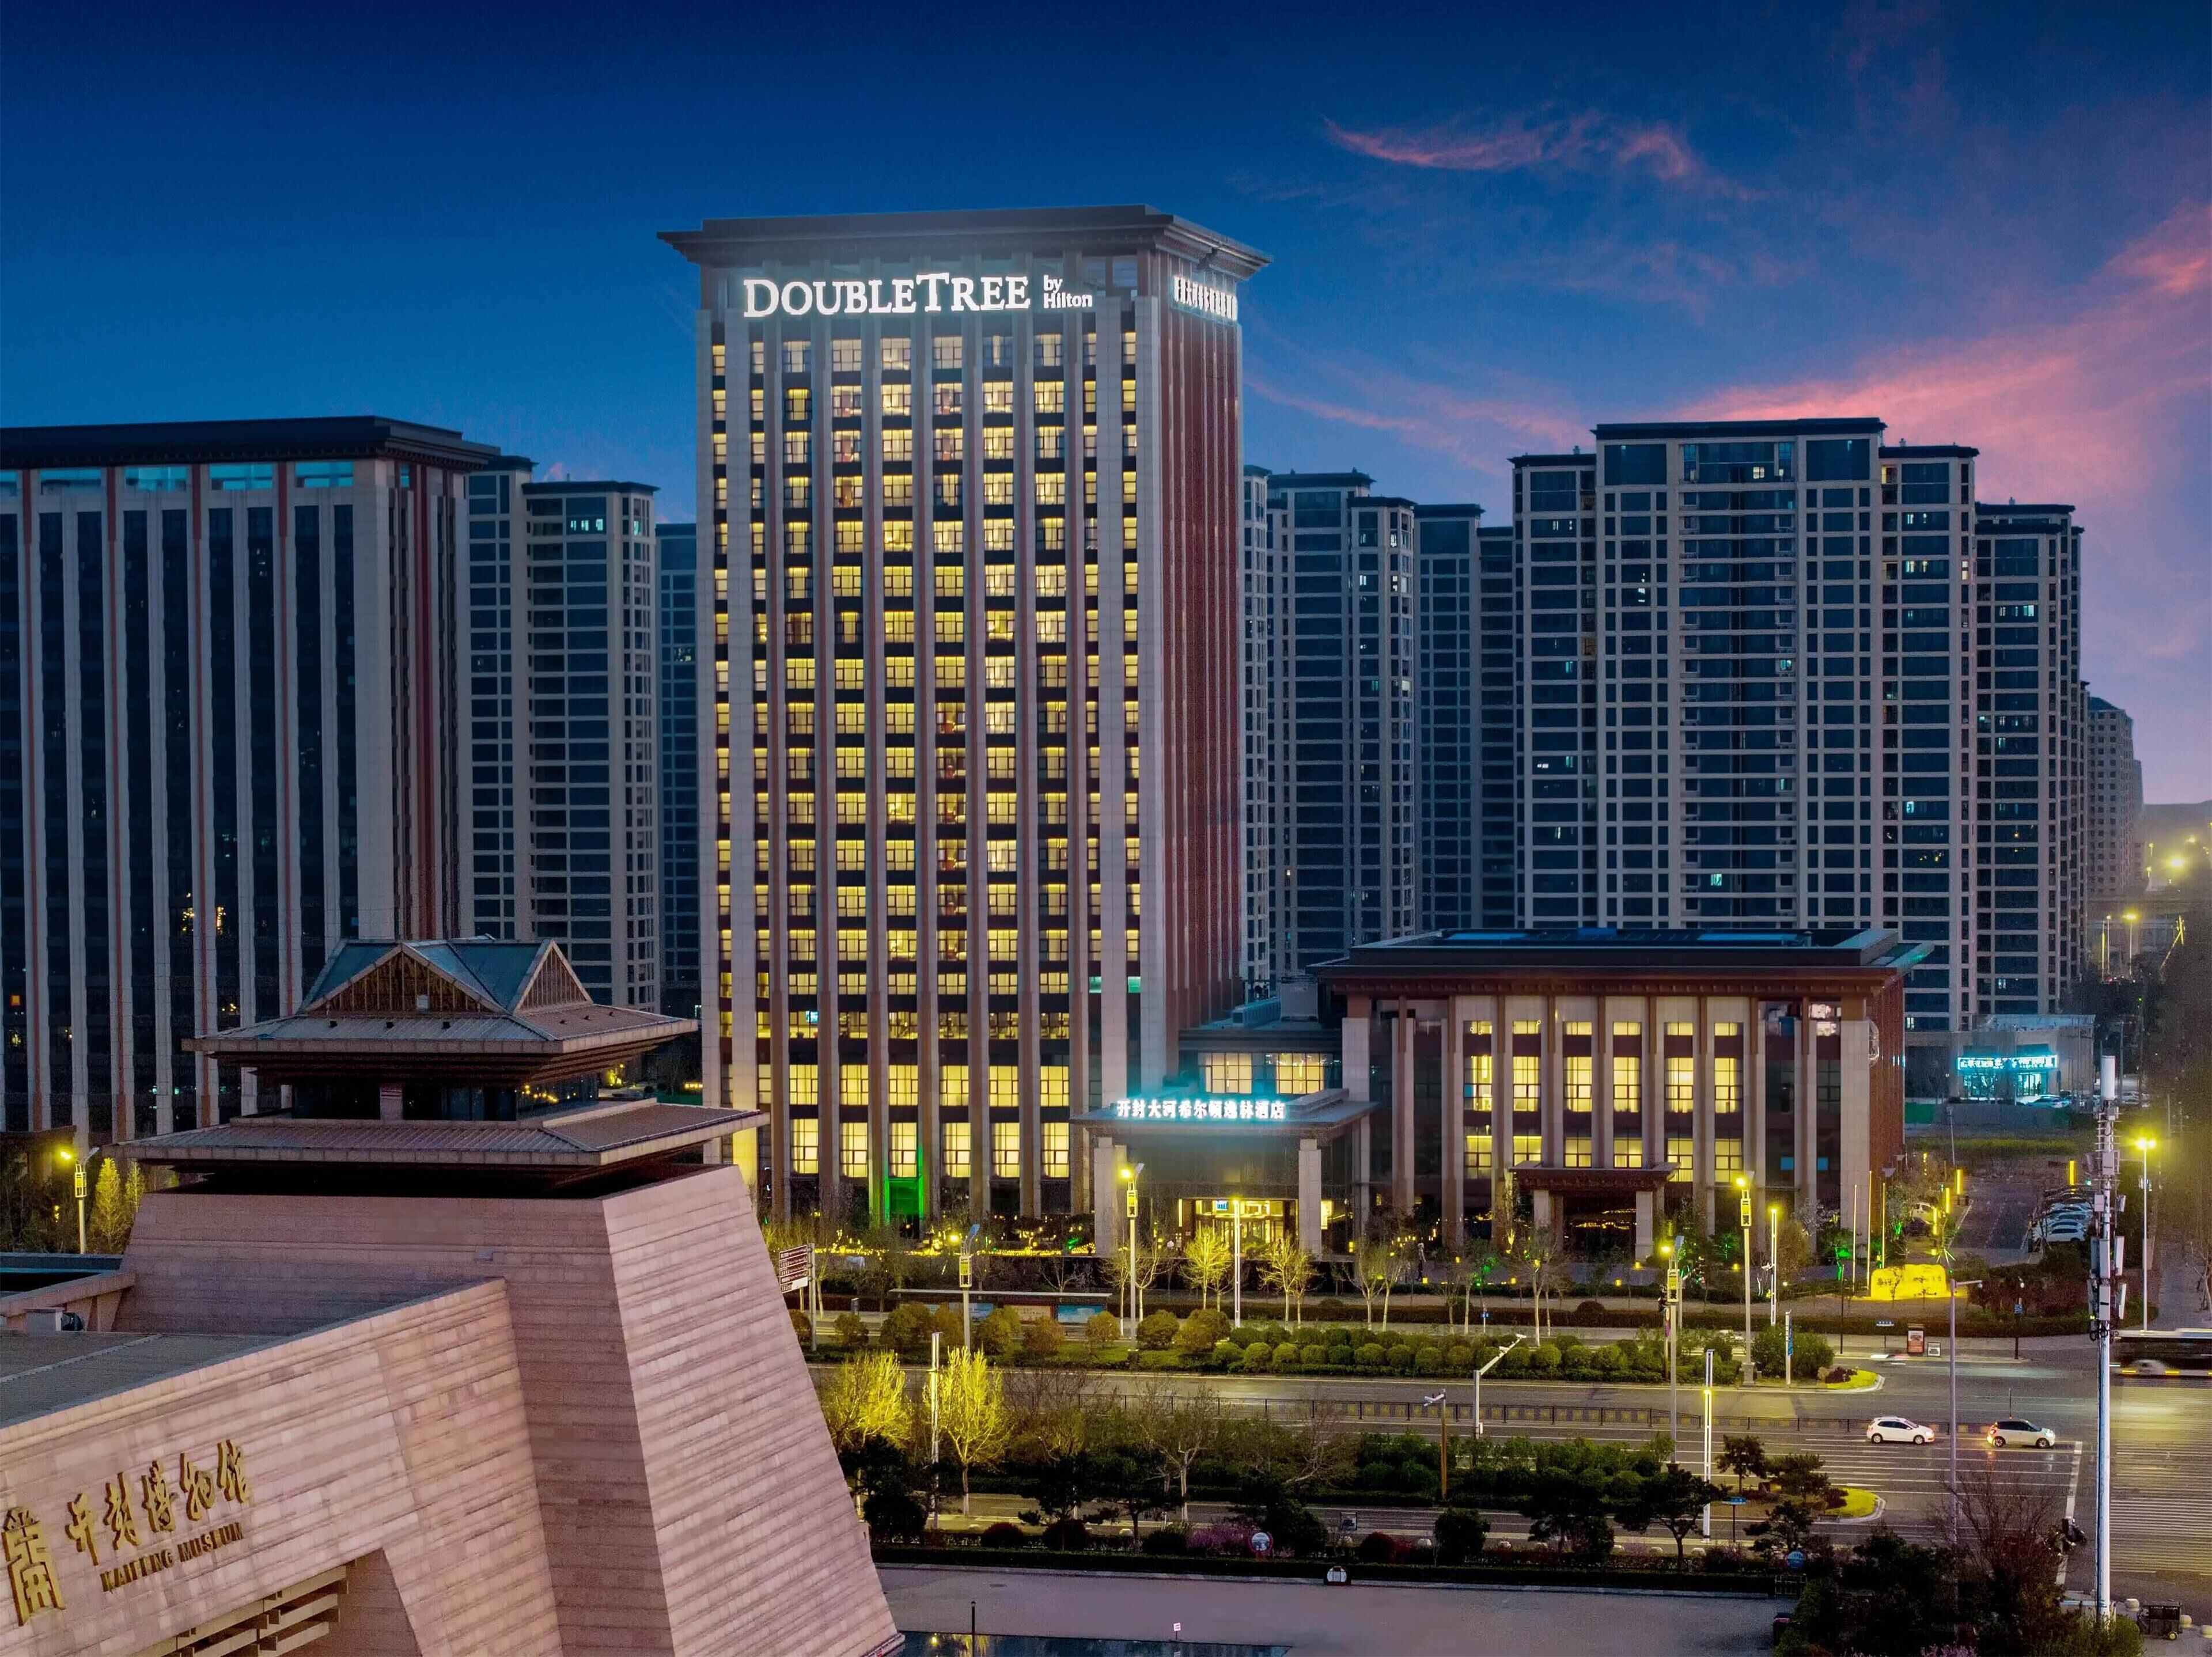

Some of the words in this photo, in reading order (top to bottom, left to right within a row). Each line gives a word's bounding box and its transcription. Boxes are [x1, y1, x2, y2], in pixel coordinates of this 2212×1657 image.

[1043, 275, 1063, 293] by
[744, 272, 1031, 317] DOUBLETREE
[1043, 292, 1093, 309] Hilton
[1117, 1099, 1285, 1118] 开封大河希尔顿逸林酒店
[100, 1548, 175, 1592] KAIFENG
[177, 1522, 244, 1563] MUSEUM
